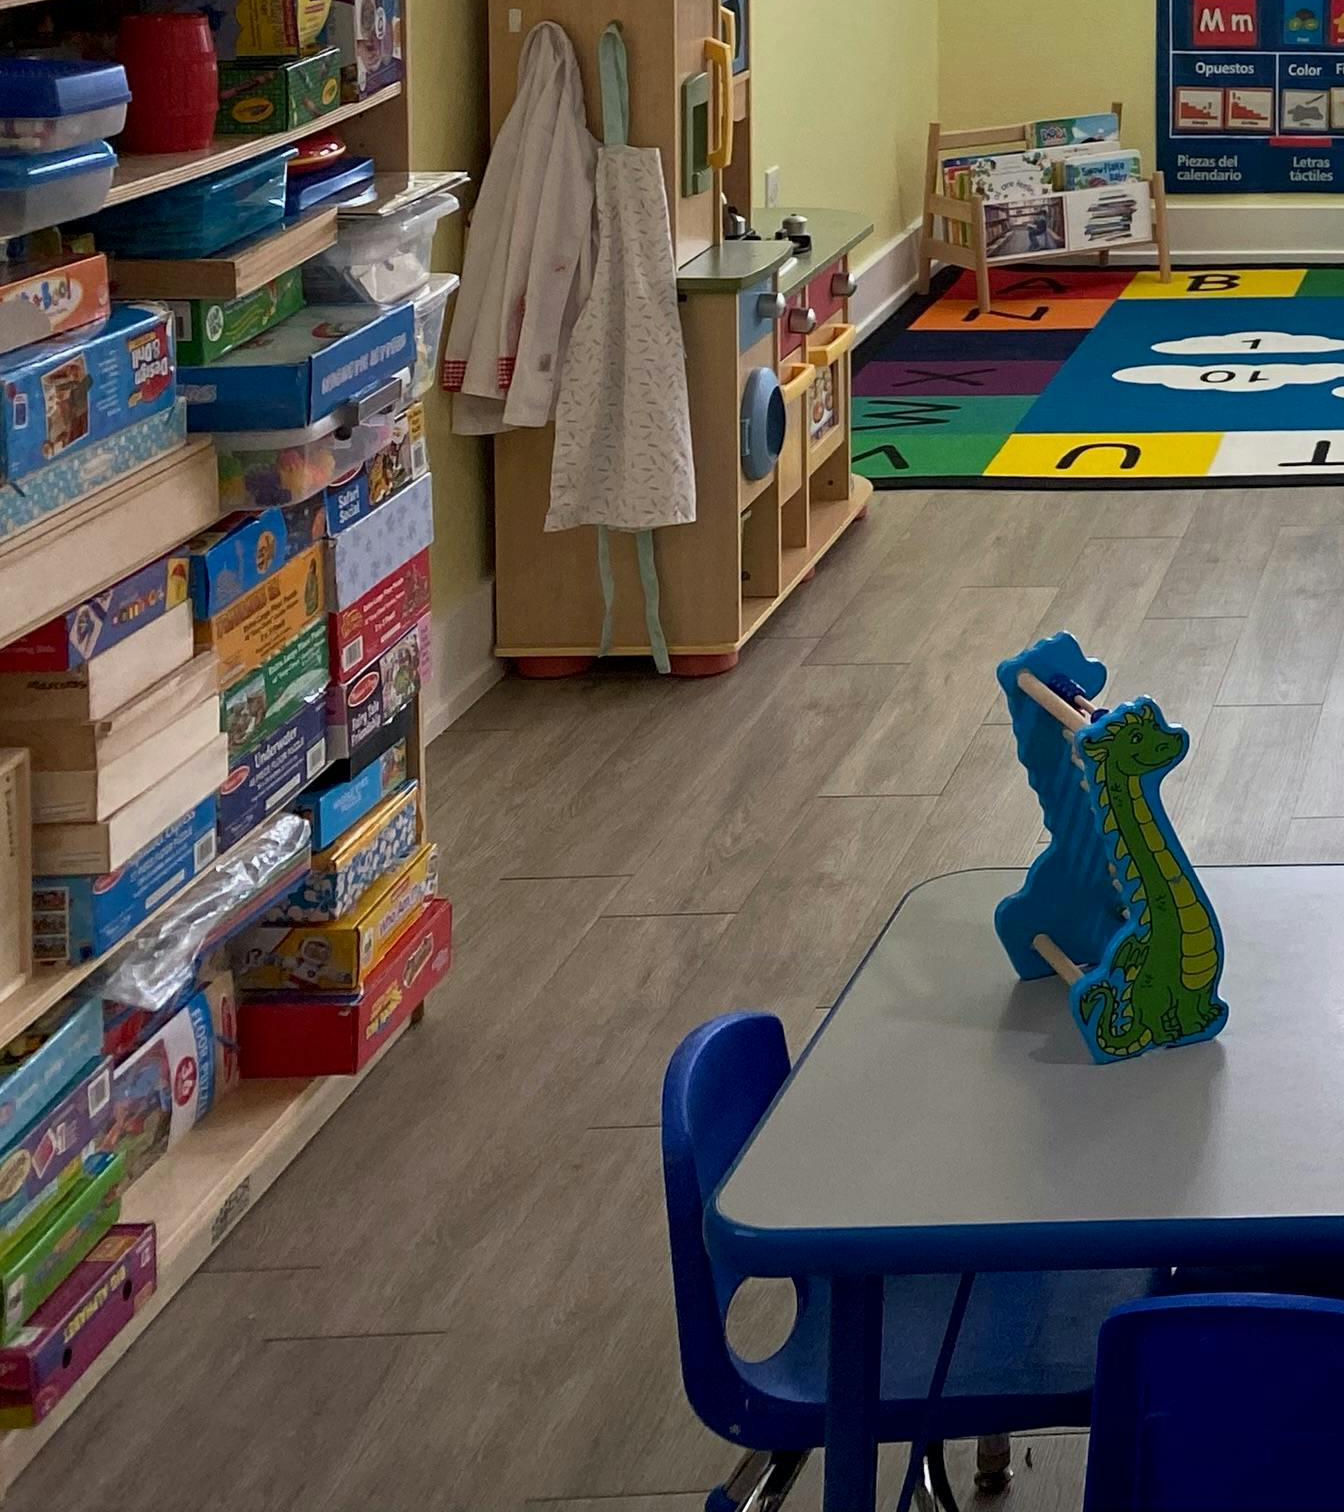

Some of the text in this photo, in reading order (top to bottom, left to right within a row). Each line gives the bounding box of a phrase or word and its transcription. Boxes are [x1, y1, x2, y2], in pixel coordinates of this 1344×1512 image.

[1196, 62, 1255, 79] Opuestos
[1288, 64, 1322, 76] Color
[1178, 154, 1238, 167] Piezas del
[1293, 156, 1330, 168] Letras
[1177, 169, 1242, 182] calendario
[1290, 168, 1333, 182] táctiles
[1186, 274, 1242, 292] B
[962, 306, 1051, 322] Z
[1242, 338, 1262, 350] 1
[135, 358, 169, 385] Design
[892, 368, 996, 387] X
[1199, 370, 1270, 383] 10
[1055, 442, 1142, 470] U
[254, 727, 298, 769] Underwater
